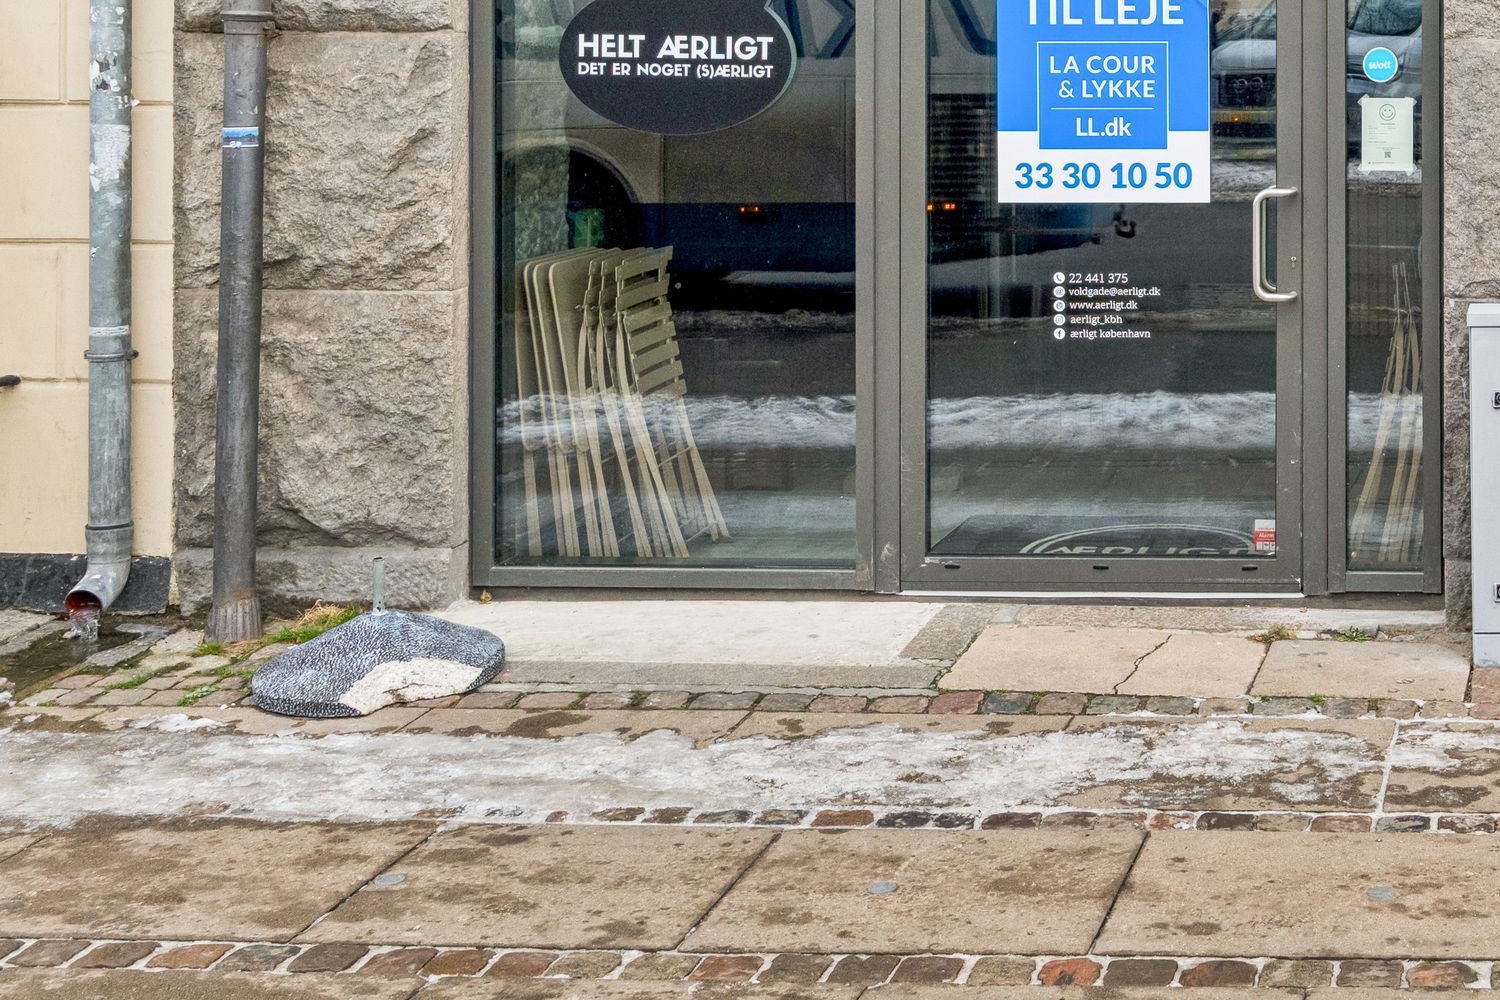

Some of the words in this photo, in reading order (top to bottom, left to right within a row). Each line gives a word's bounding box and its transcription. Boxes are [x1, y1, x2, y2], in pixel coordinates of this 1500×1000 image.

[579, 34, 645, 57] HELT
[657, 35, 773, 60] ÆRLIGT
[578, 62, 606, 75] DET
[613, 63, 630, 75] ER
[637, 63, 691, 76] NOGET
[1050, 56, 1080, 73] LA
[1087, 56, 1155, 73] COUR
[1368, 60, 1392, 70] Wolt
[1059, 80, 1074, 98] &
[1082, 80, 1155, 97] LYKKE
[1077, 117, 1131, 136] LL.dk
[1015, 163, 1053, 188] 33
[1063, 163, 1100, 188] 30
[1111, 163, 1147, 188] 10
[1155, 163, 1192, 188] 50
[1069, 273, 1082, 283] 22
[1085, 273, 1104, 283] 441
[1108, 273, 1128, 283] 375
[1069, 287, 1160, 297] voldgade@aerligt.dk
[1069, 301, 1137, 311] www.aerligt.dk
[1070, 315, 1123, 326] aerligt_kbh
[1070, 329, 1097, 340] ærligt
[1100, 329, 1150, 338] københavn
